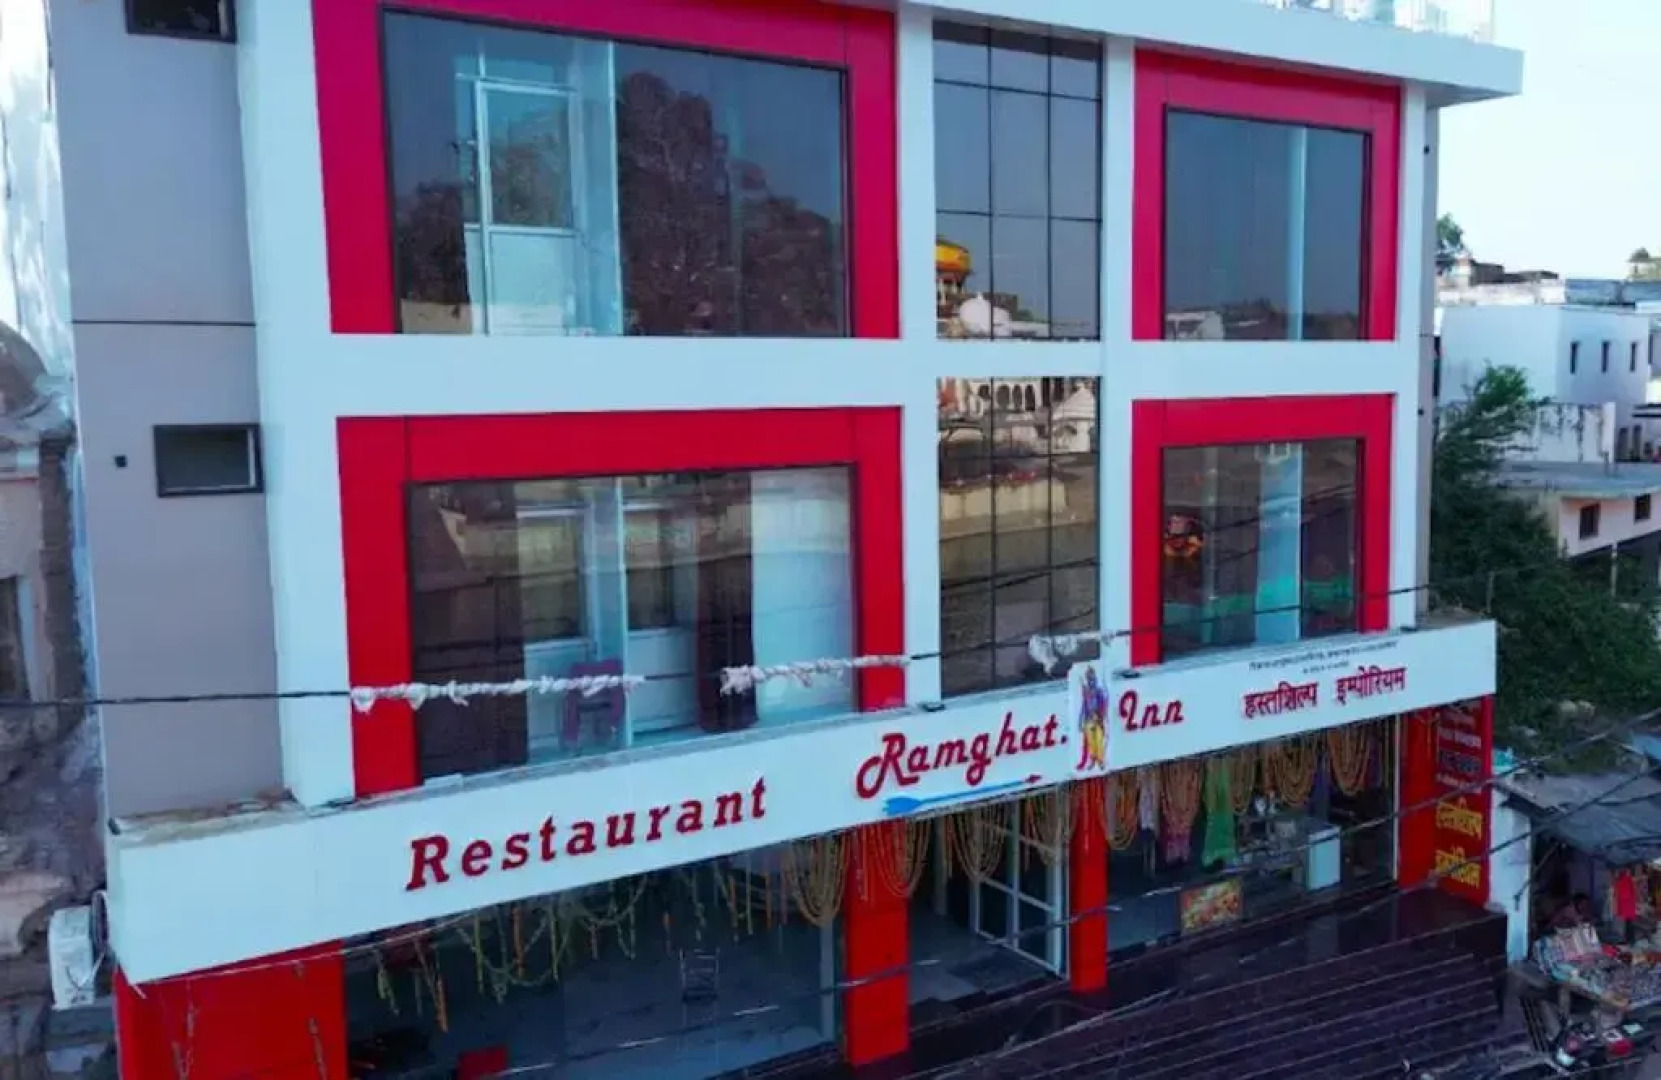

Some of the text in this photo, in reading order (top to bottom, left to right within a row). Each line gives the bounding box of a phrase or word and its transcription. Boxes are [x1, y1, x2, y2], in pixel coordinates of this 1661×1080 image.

[1336, 666, 1407, 704] इम्पोरियम
[1119, 690, 1184, 733] Inn
[406, 775, 766, 890] Restaurant
